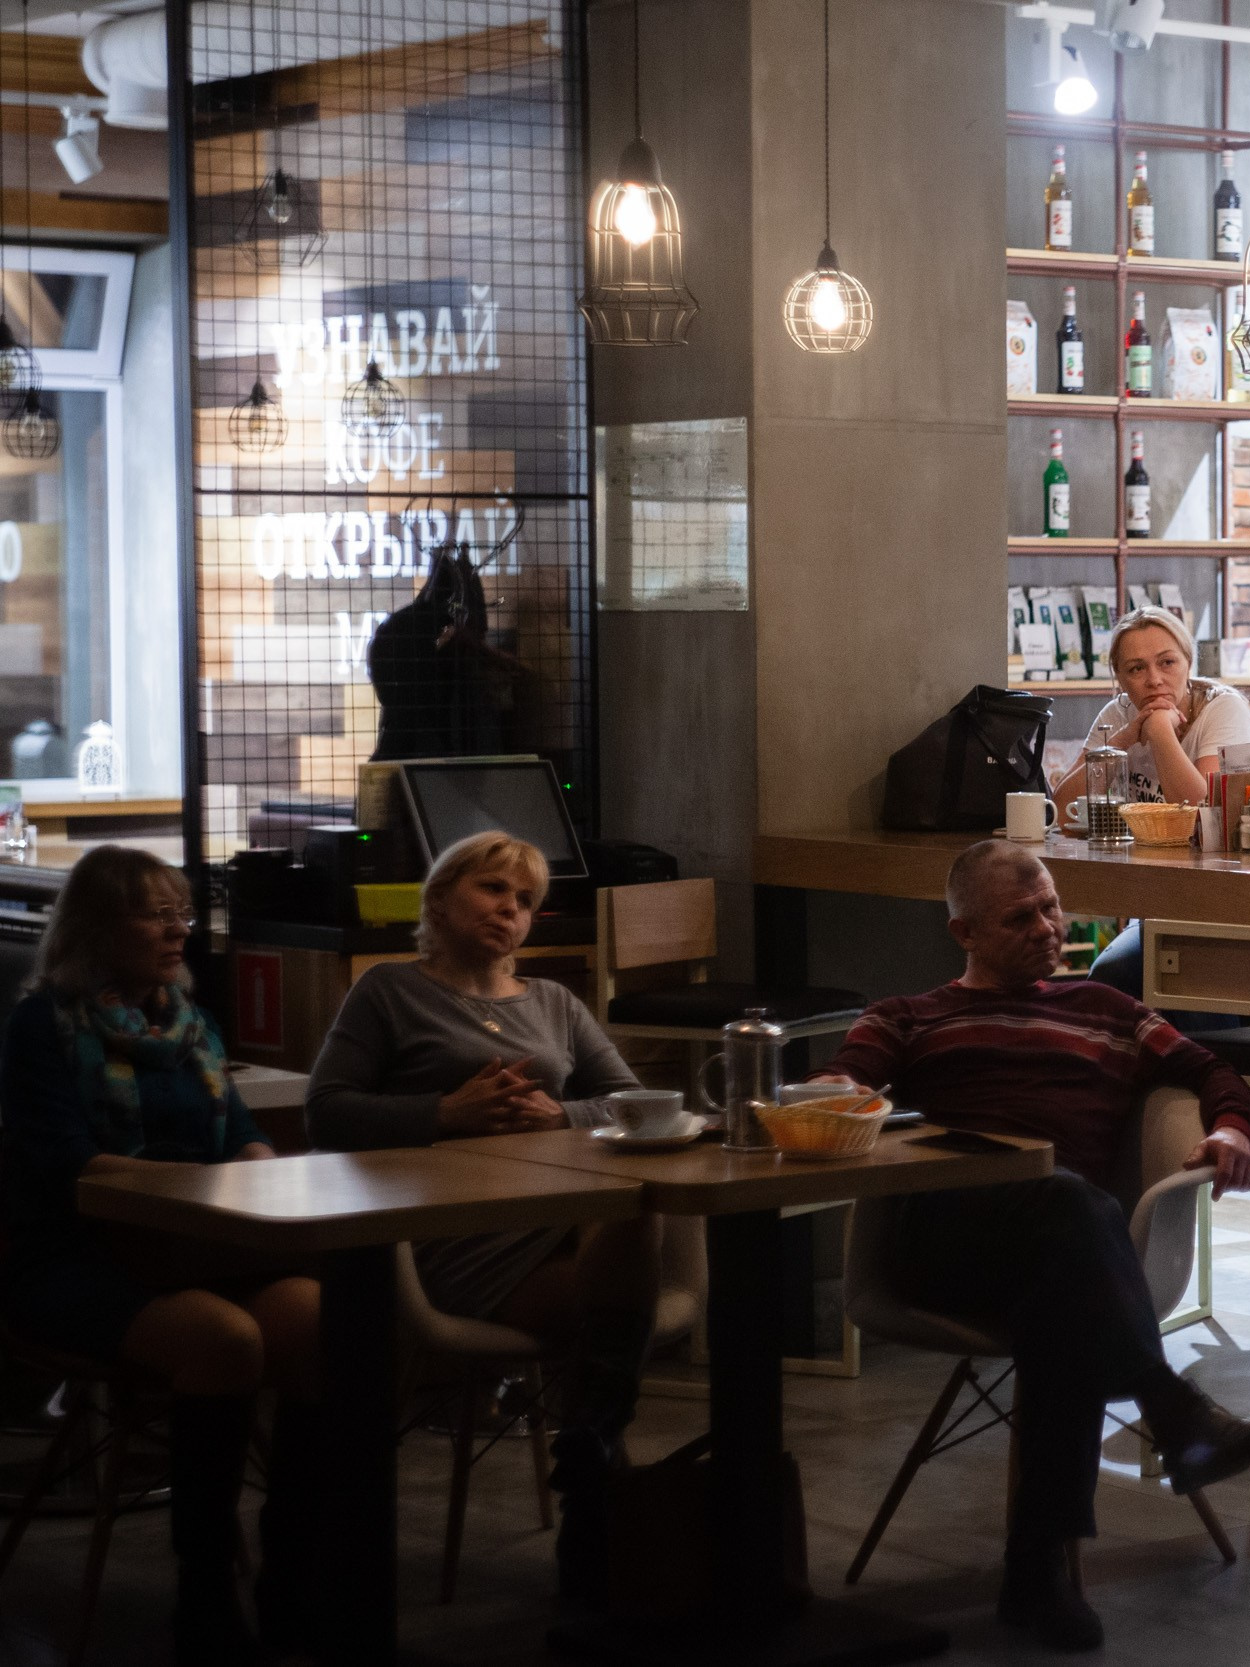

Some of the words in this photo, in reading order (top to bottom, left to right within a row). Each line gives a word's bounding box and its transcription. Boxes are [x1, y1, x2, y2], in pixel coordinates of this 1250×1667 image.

[270, 284, 500, 389] УЗНАВАЙ
[324, 411, 445, 485] КОФЕ
[253, 486, 521, 580] ОТКРЫВАЙ
